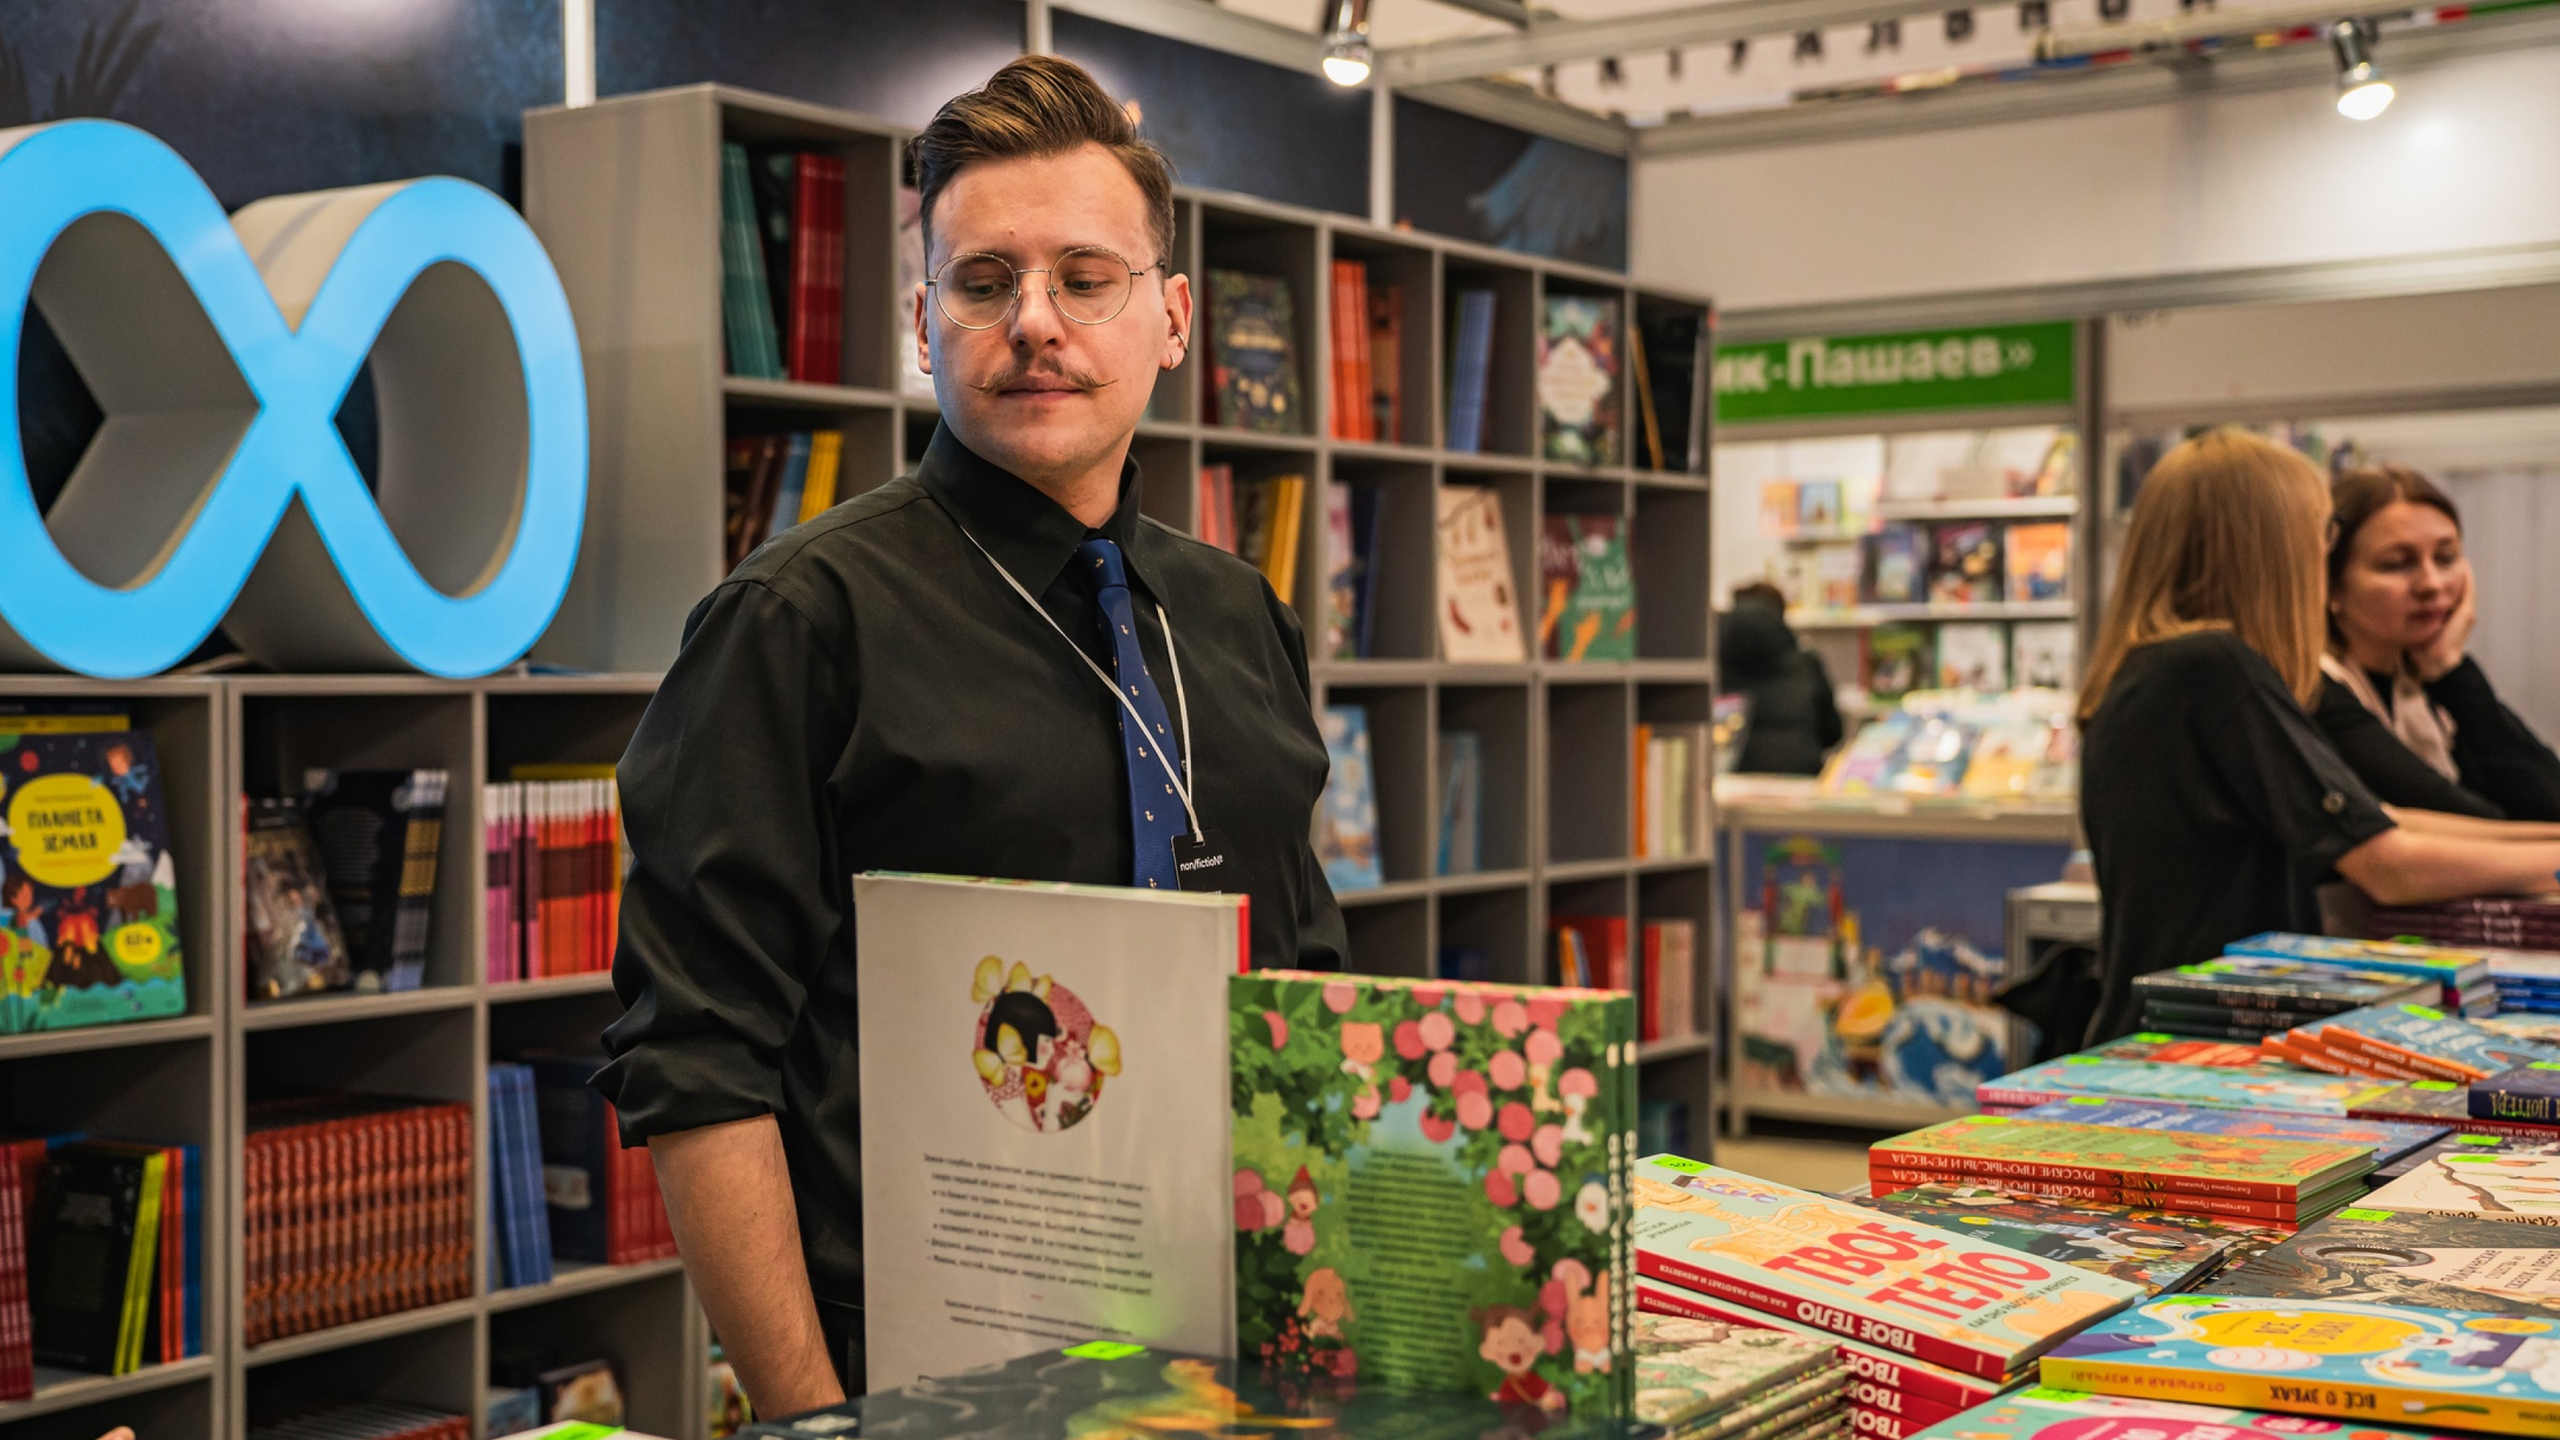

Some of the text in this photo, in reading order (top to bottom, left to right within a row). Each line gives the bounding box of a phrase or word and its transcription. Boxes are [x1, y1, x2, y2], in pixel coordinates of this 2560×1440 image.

[27, 809, 105, 829] ПЛАНЕТА
[43, 833, 98, 853] ЗЕМЛЯ
[1891, 1153, 2096, 1182] РУССКИЕ ПРОМЫСЛЫ И РЕМЕСЛА
[2040, 1182, 2096, 1198] РУССКИЕ
[2175, 1180, 2251, 1195] Екатерина Пушкина
[2175, 1198, 2250, 1213] Екатерина Пушкина
[1761, 1222, 1950, 1286] ТВОЕ
[1864, 1252, 2051, 1320] ТЕЛО
[1643, 1295, 1683, 1318] МЕНЯЕТСЯ
[1659, 1264, 1917, 1354] ТВОЕ ТЕЛО КАК ОНО РАБОТАЕТ И МЕНЯЕТСЯ
[2071, 1370, 2226, 1393] ОТКРЫВАЙ И ИЗУЧАЙ!
[2269, 1385, 2319, 1406] ЗУБАХ
[2325, 1390, 2337, 1406] О
